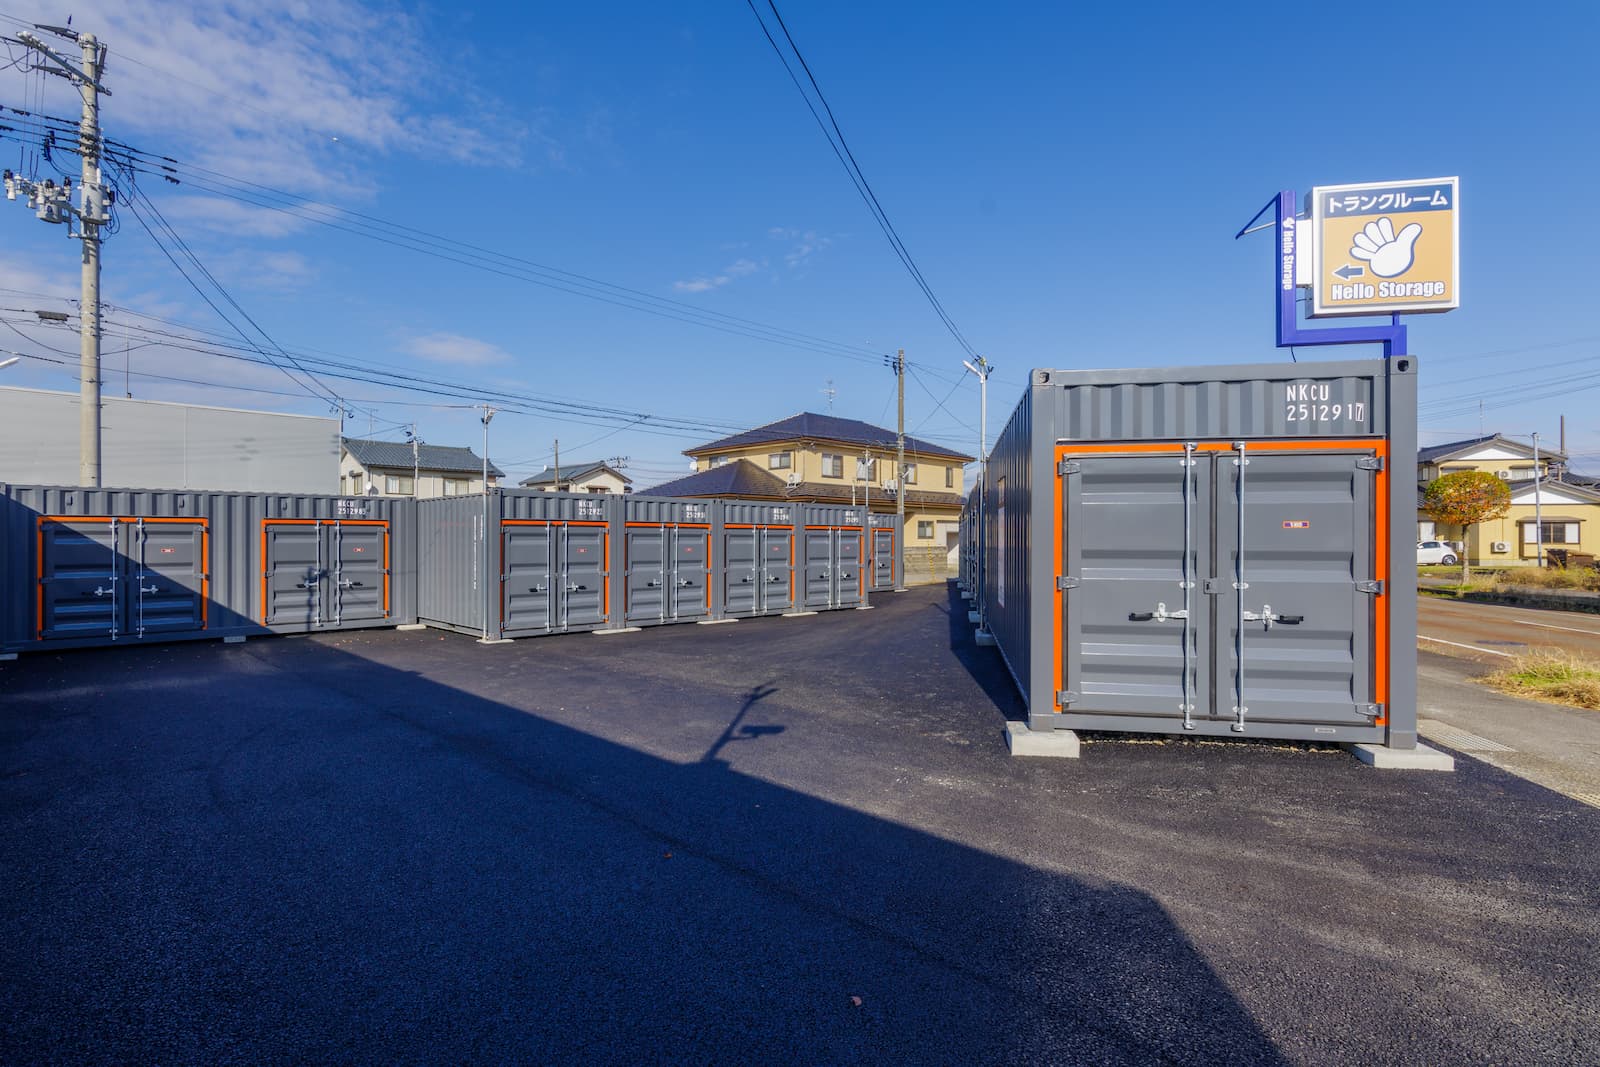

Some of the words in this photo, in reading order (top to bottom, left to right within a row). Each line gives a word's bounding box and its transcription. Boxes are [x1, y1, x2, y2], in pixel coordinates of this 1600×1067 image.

[1329, 190, 1448, 213] トランクルーム
[1283, 231, 1294, 254] Hello
[1282, 255, 1294, 290] Storage
[1331, 282, 1375, 300] Hello
[1378, 281, 1445, 298] Storage
[1286, 384, 1329, 402] NKCU
